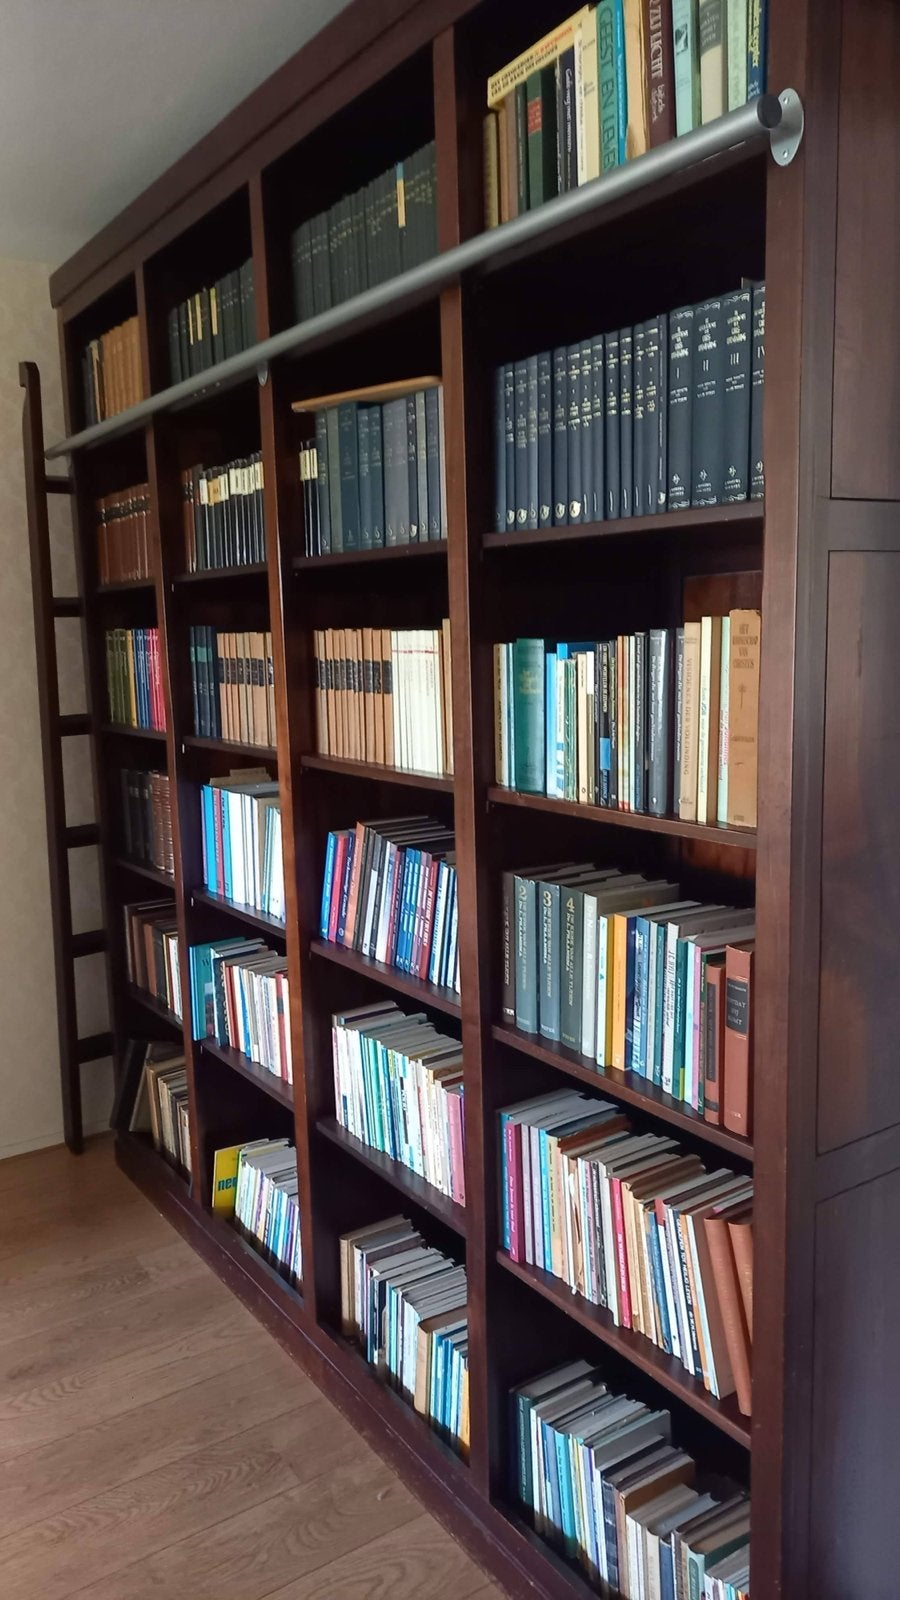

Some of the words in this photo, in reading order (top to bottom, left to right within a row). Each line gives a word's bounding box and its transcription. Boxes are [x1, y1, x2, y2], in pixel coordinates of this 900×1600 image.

[600, 6, 614, 67] GEEST
[602, 78, 615, 110] EN
[703, 360, 709, 371] II
[730, 352, 739, 365] III
[685, 657, 693, 704] VISIOENEN
[683, 725, 691, 775] VOLEINDING
[519, 885, 527, 900] 2
[543, 890, 552, 907] 3
[566, 897, 574, 913] 4
